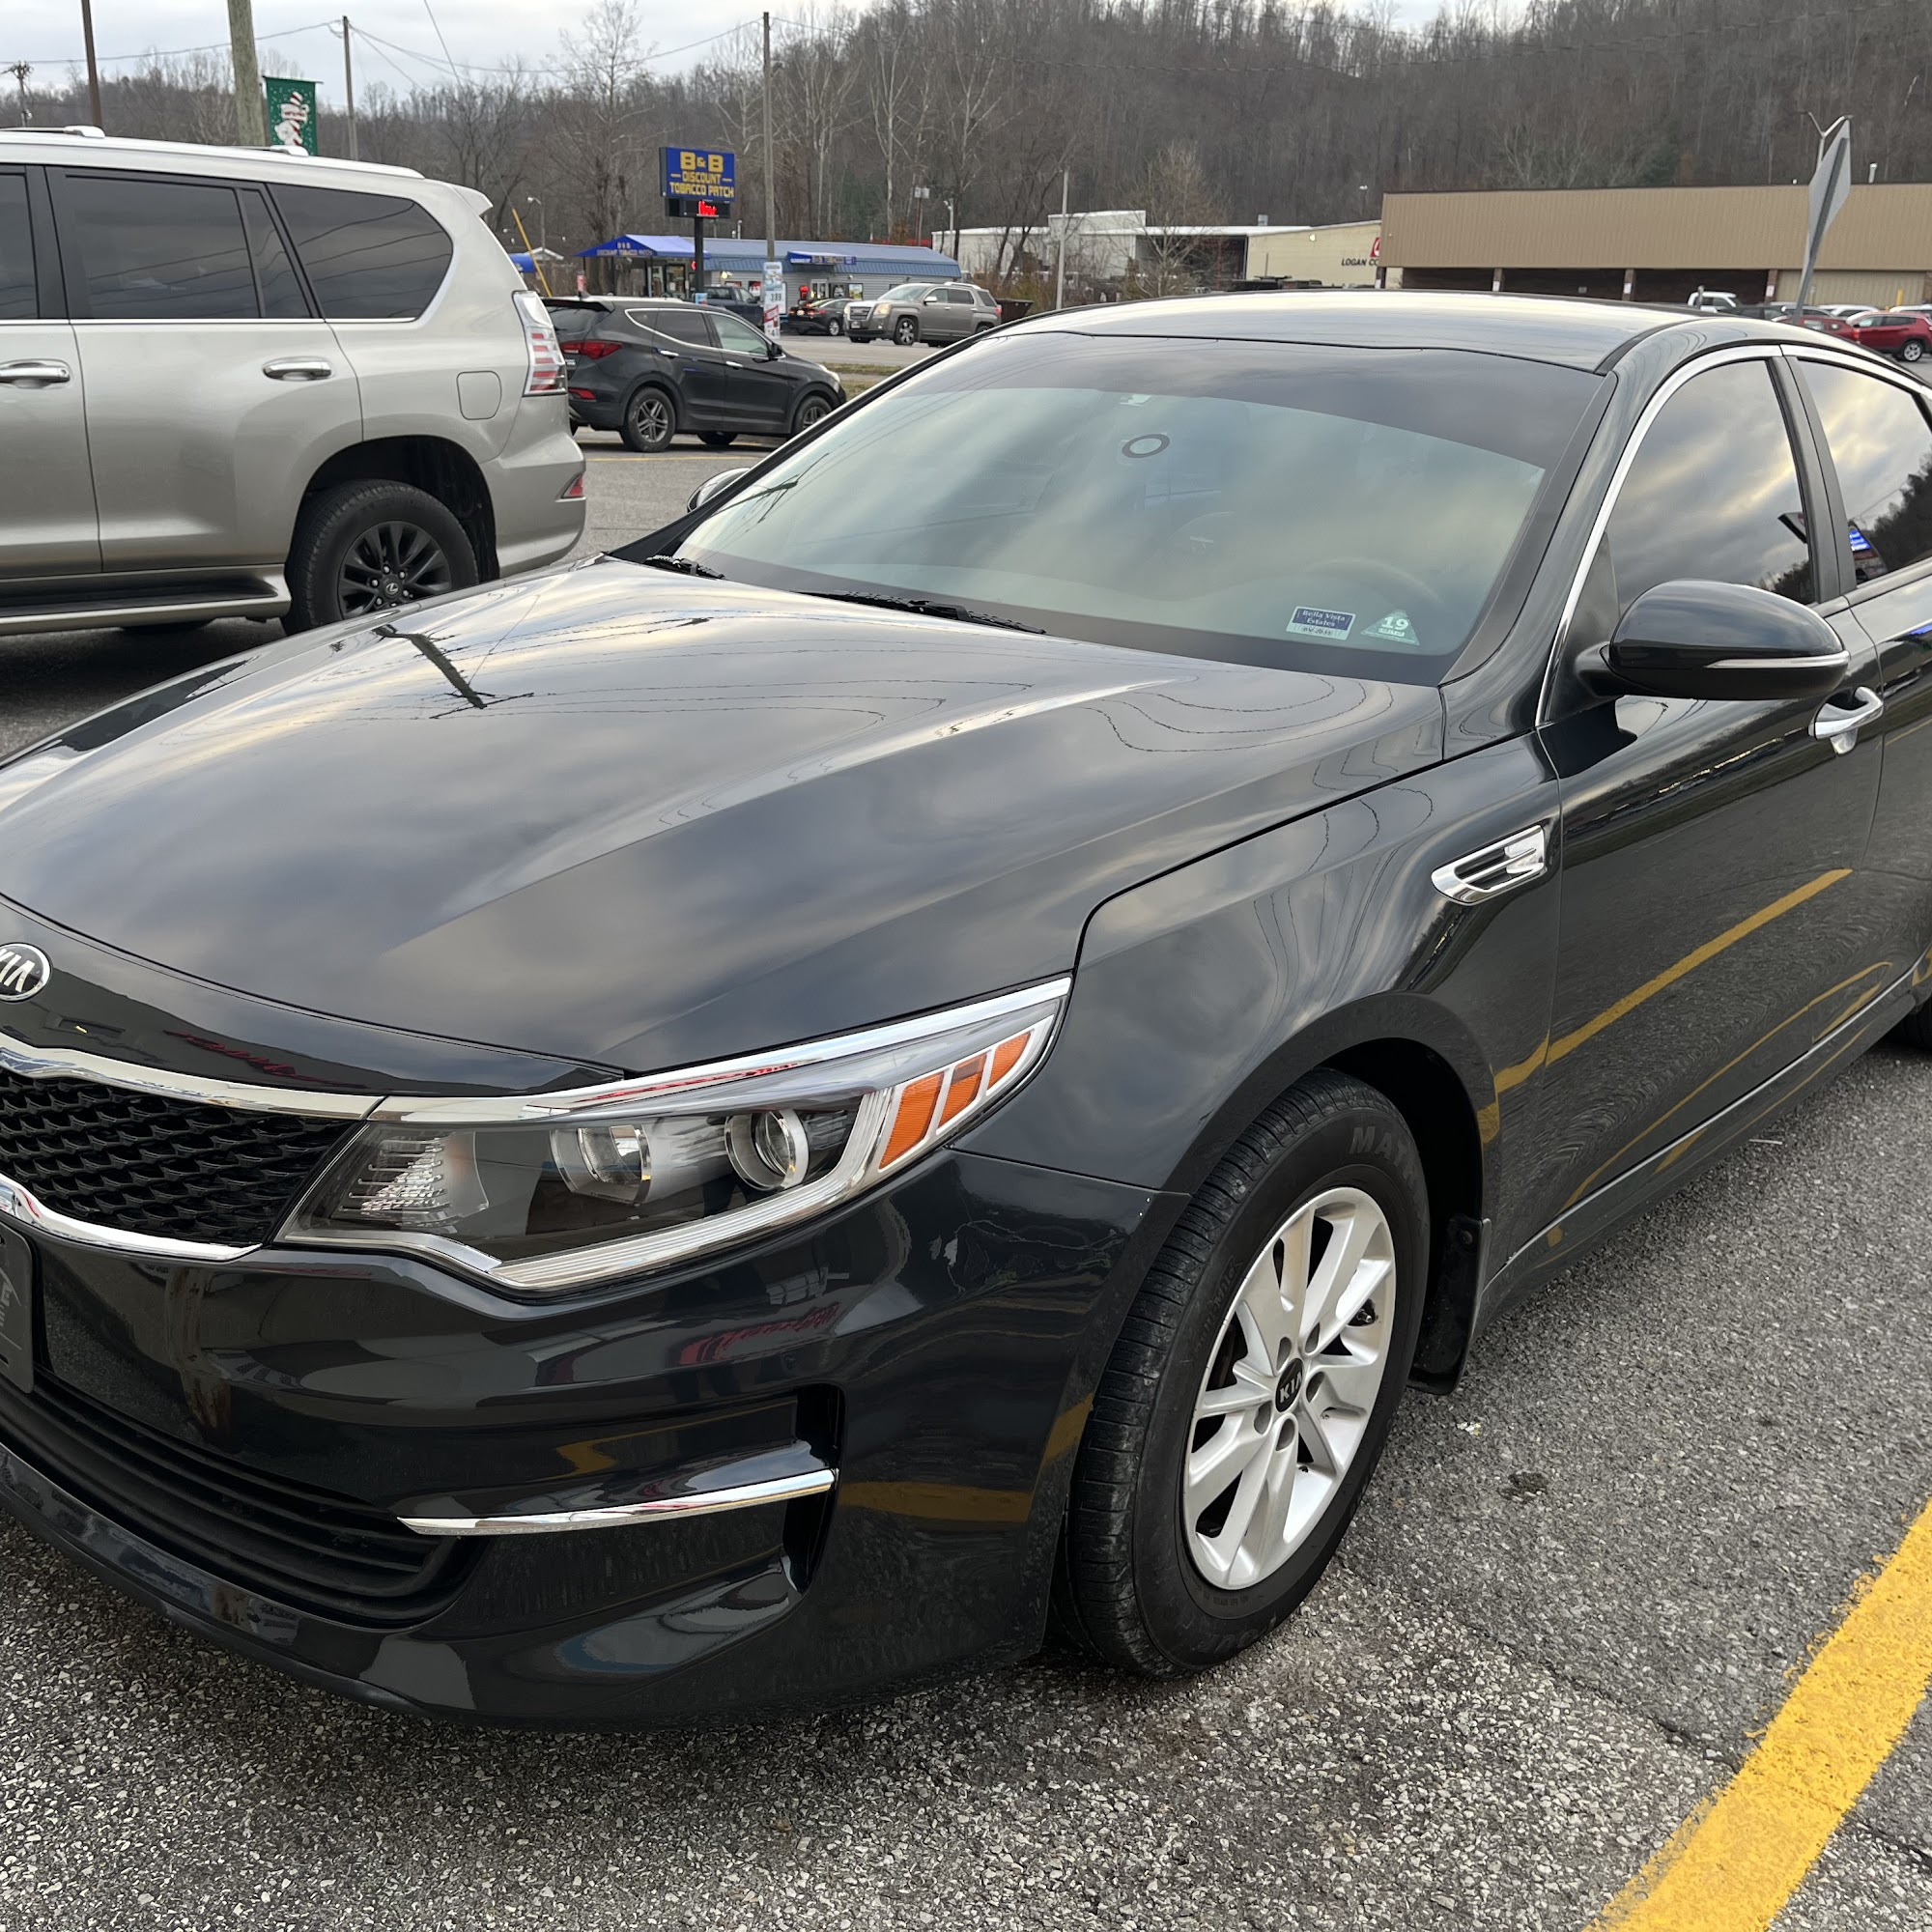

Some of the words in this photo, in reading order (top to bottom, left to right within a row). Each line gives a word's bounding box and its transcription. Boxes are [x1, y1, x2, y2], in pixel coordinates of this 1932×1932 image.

[680, 152, 724, 173] B&B
[682, 171, 722, 185] DISCOUNT
[669, 182, 707, 196] TOBACCO
[708, 185, 734, 199] PATCH
[1341, 258, 1367, 267] LOGAN
[1302, 610, 1323, 619] Bella
[1324, 612, 1346, 622] Vista
[1306, 617, 1336, 627] Estates
[1380, 616, 1409, 631] 19
[1280, 1371, 1302, 1404] KIA
